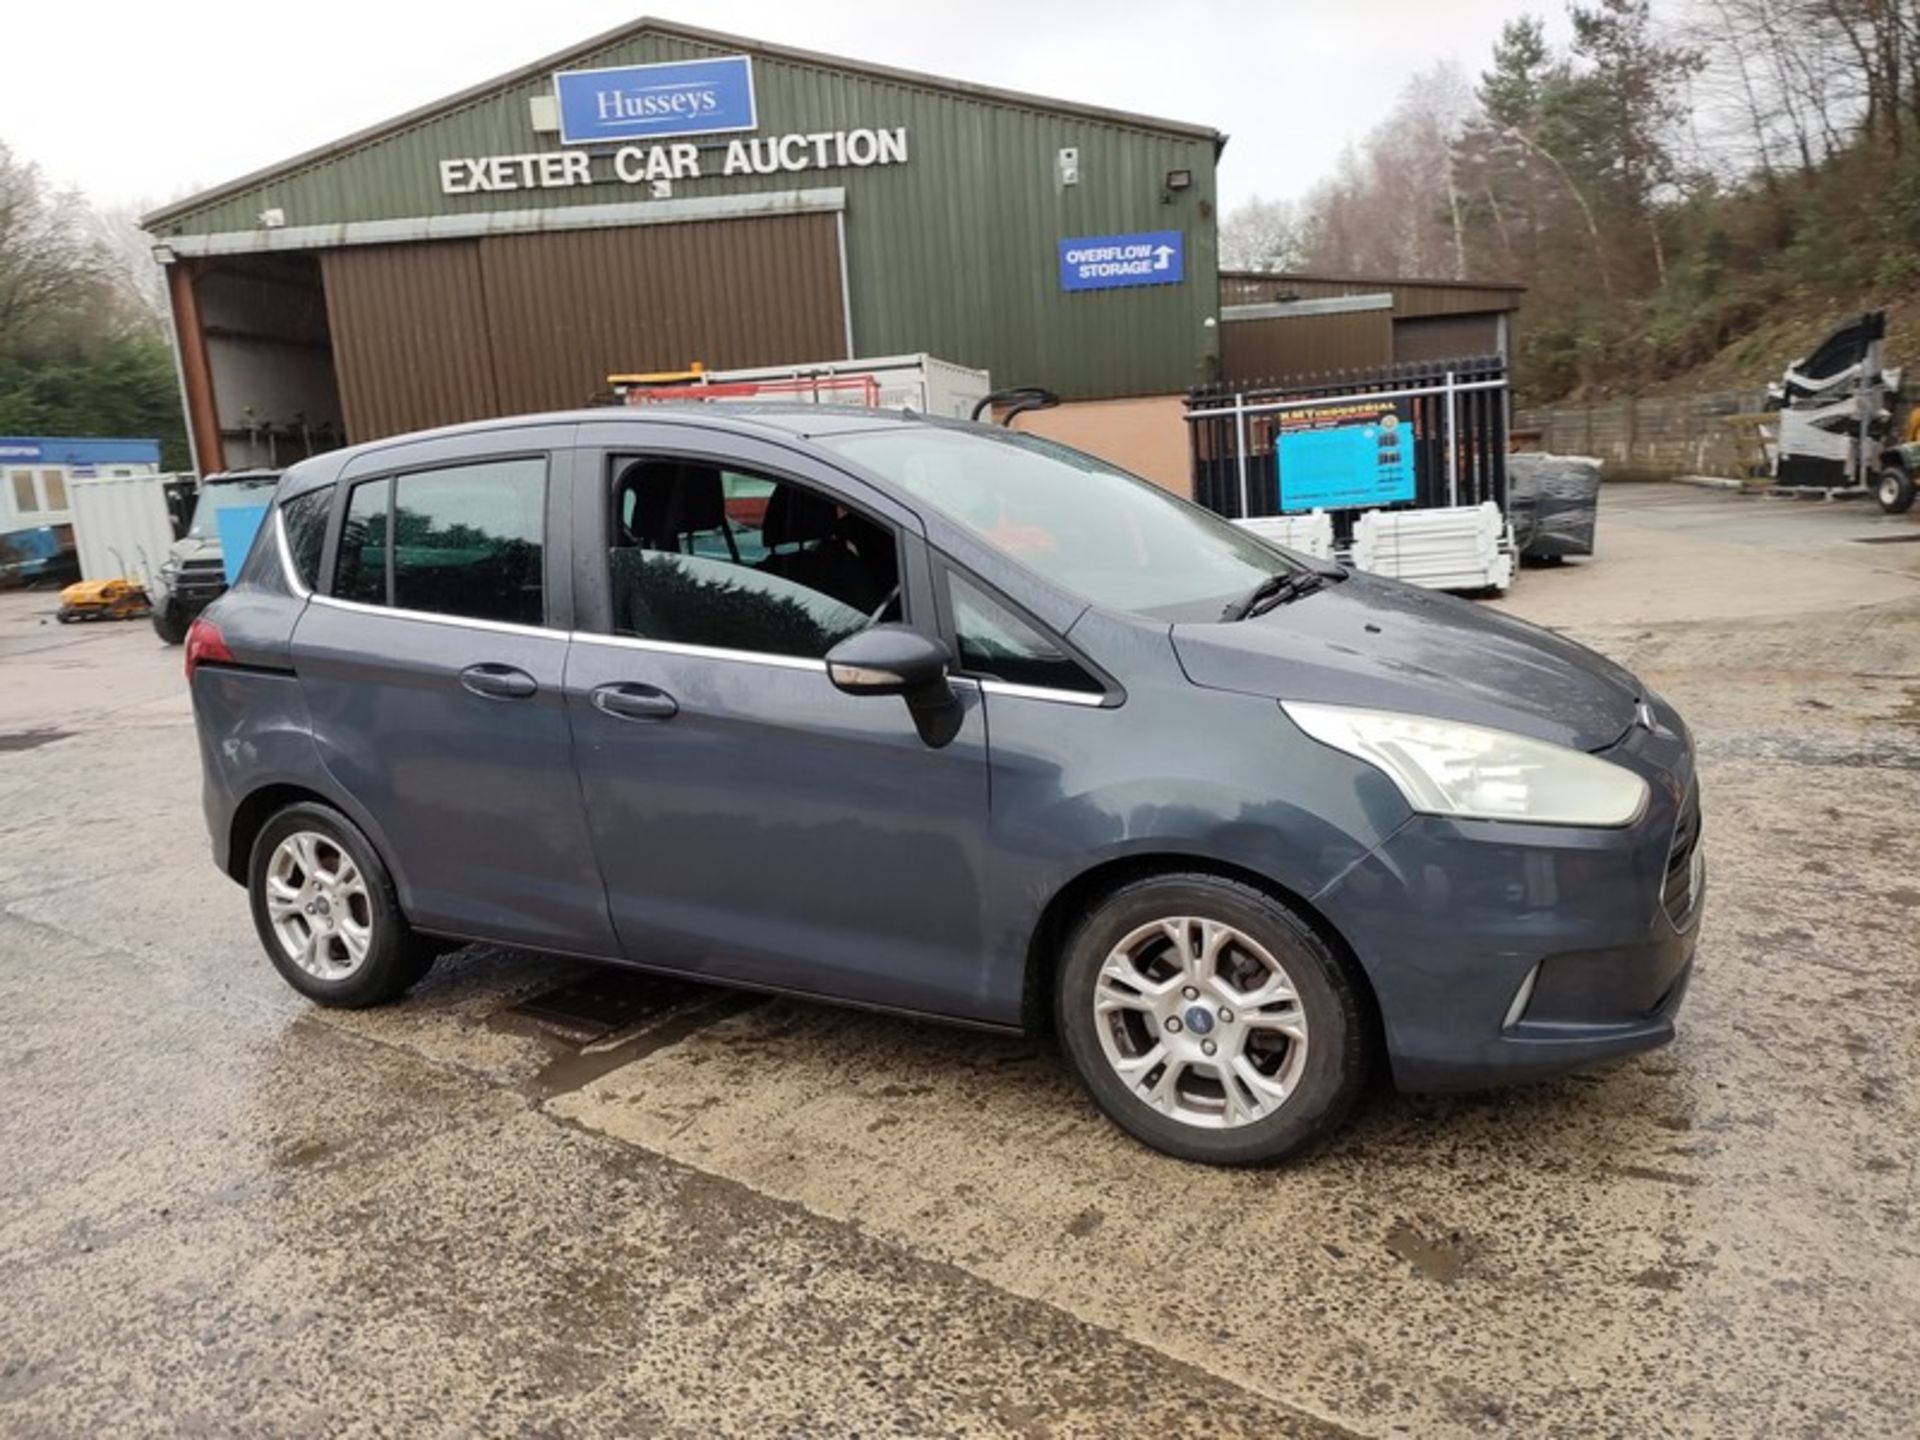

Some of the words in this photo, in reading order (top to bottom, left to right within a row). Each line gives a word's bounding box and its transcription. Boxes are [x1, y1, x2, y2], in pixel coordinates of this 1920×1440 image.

[596, 89, 716, 118] Husseys
[440, 151, 591, 193] EXETER
[614, 144, 699, 183] CAR
[724, 127, 908, 174] AUCTION
[1066, 245, 1152, 263] OVERFLOW
[1079, 260, 1153, 278] STORAGE
